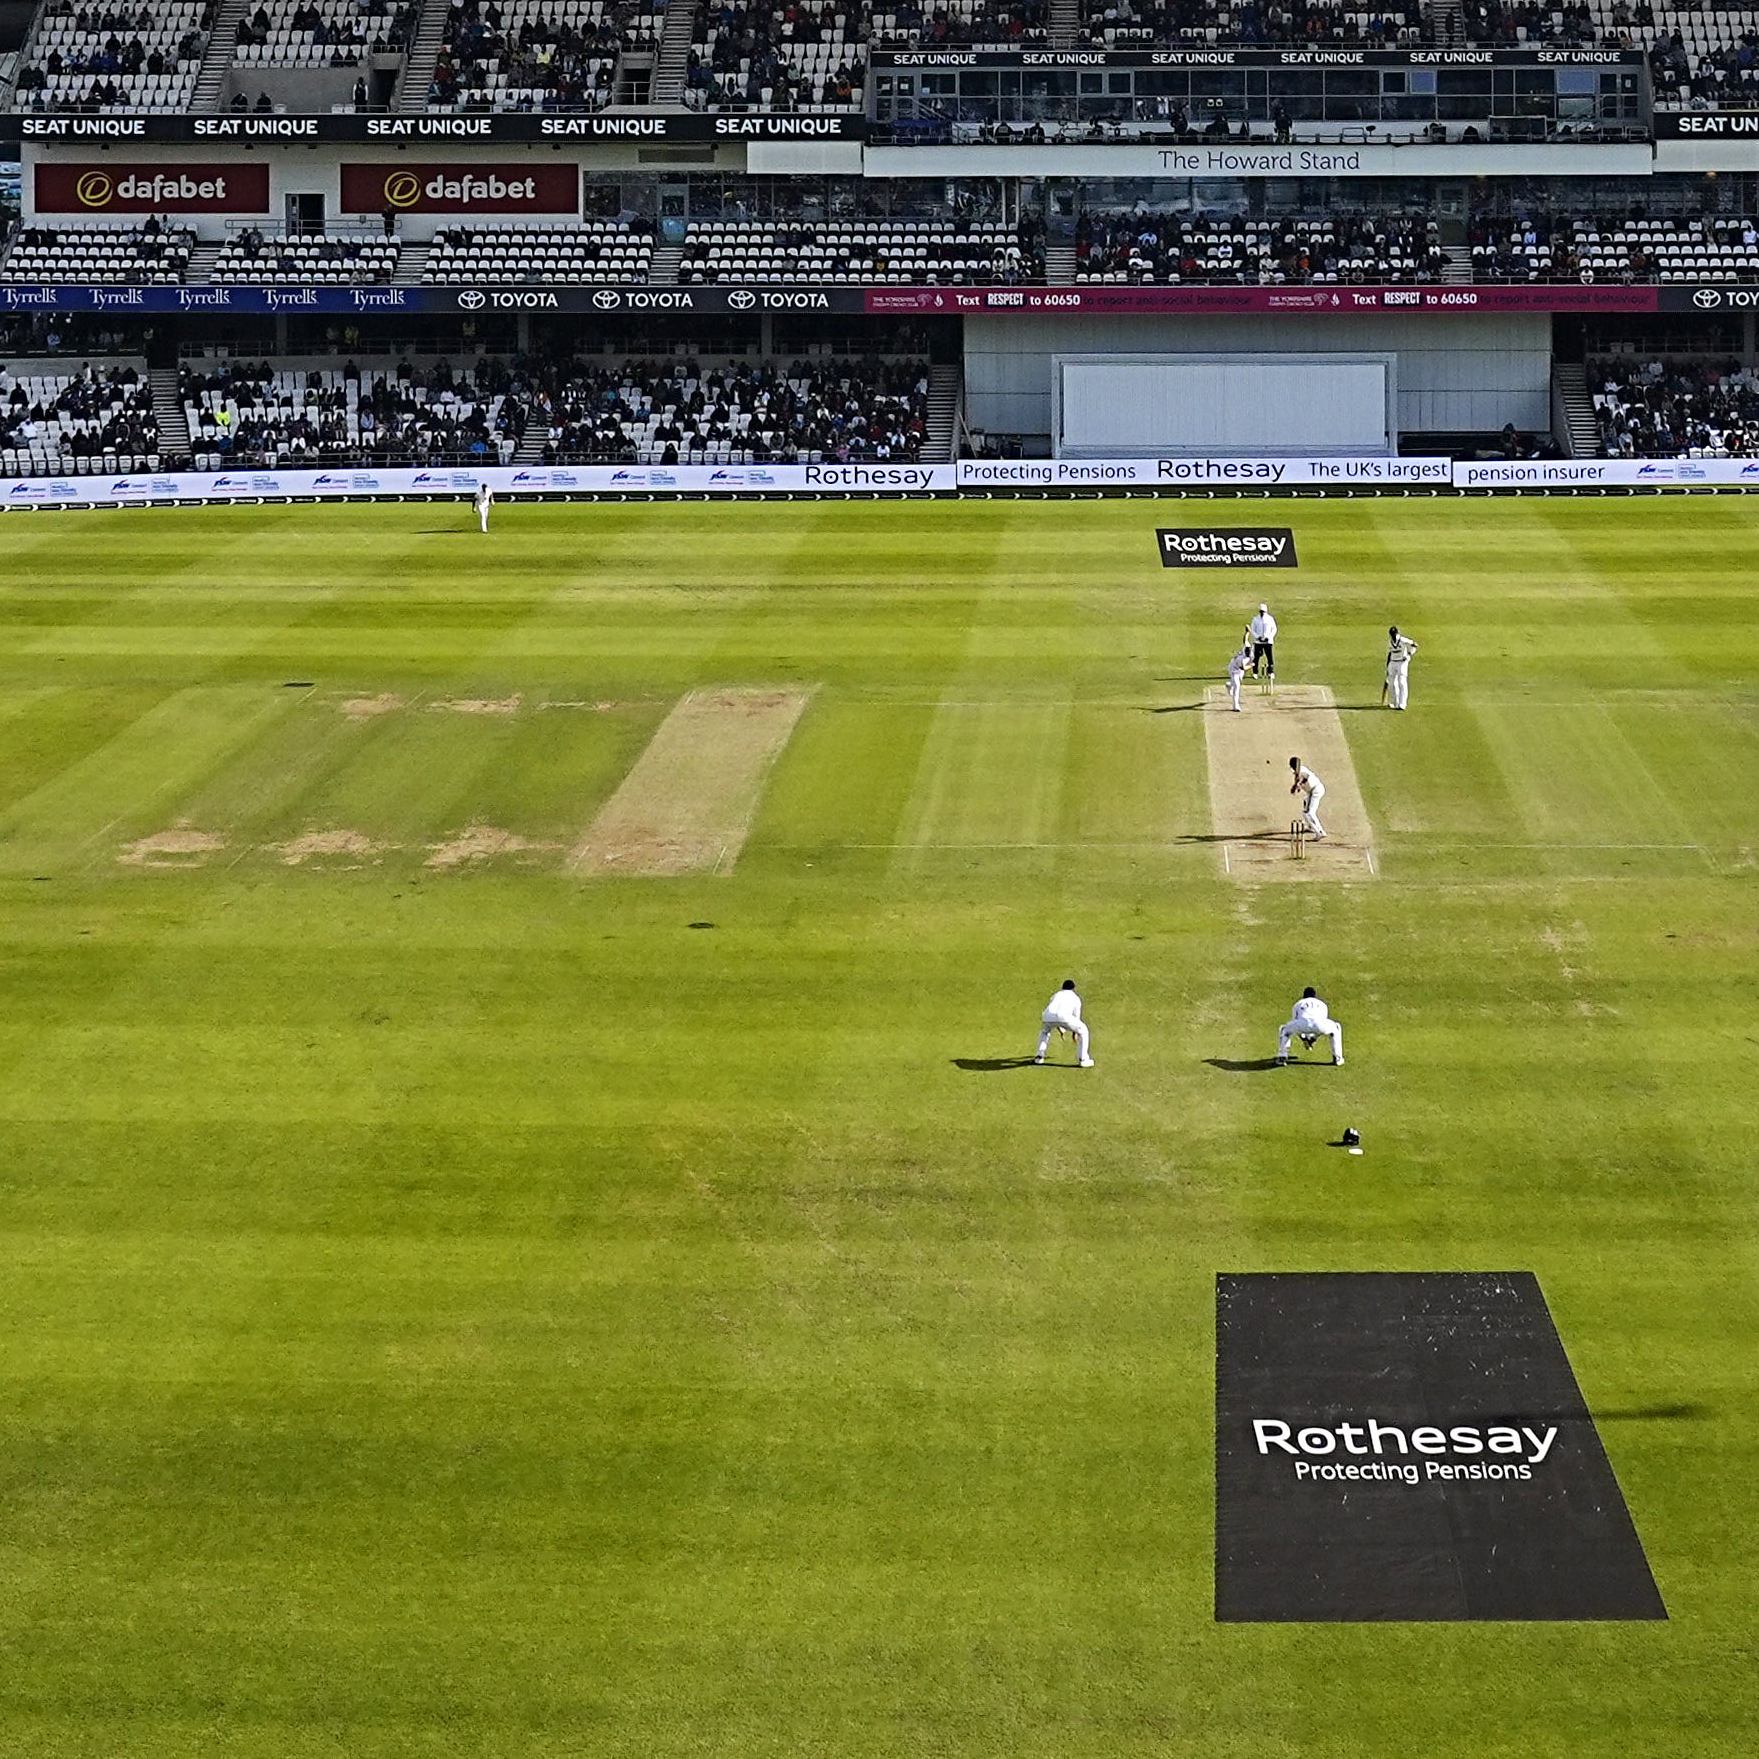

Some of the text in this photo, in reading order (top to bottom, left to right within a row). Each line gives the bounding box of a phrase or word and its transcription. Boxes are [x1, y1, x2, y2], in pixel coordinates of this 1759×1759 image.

[894, 54, 976, 65] SEAT UNIQUE
[1023, 53, 1105, 64] SEAT UNIQUE
[1152, 53, 1234, 64] SEAT UNIQUE
[1281, 52, 1363, 63] SEAT UNIQUE
[1410, 52, 1492, 63] SEAT UNIQUE
[1538, 51, 1620, 62] SEAT UNIQUE
[22, 119, 145, 136] SEAT UNIQUE
[194, 119, 318, 136] SEAT UNIQUE
[367, 119, 492, 136] SEAT UNIQUE
[541, 118, 666, 135] SEAT UNIQUE
[715, 118, 841, 135] SEAT UNIQUE
[1679, 116, 1727, 131] SEAT
[1158, 150, 1361, 170] The Howard Stand
[117, 174, 226, 203] dafabet
[426, 174, 535, 203] dafabet
[491, 293, 558, 307] TOYOTA
[626, 293, 694, 308] TOYOTA
[761, 293, 829, 308] TOYOTA
[956, 294, 980, 306] Text
[987, 292, 1024, 306] RESPECT
[1030, 295, 1042, 306] to
[1044, 294, 1081, 306] 60650
[1352, 293, 1376, 305] Text
[1384, 291, 1421, 305] RESPECT
[1426, 294, 1438, 305] to
[1441, 293, 1478, 305] 60650
[804, 465, 935, 490] Rothesay
[963, 463, 1136, 483] Protecting Pensions
[1156, 459, 1286, 482] Rothesay
[1308, 461, 1448, 479] The UK's largest
[1468, 464, 1606, 485] pension insurer
[1163, 532, 1287, 554] Rothesay
[1180, 552, 1277, 564] Protecting Pensions
[1252, 1419, 1559, 1463] Rothesay
[1295, 1460, 1533, 1485] Protecting Pensions
